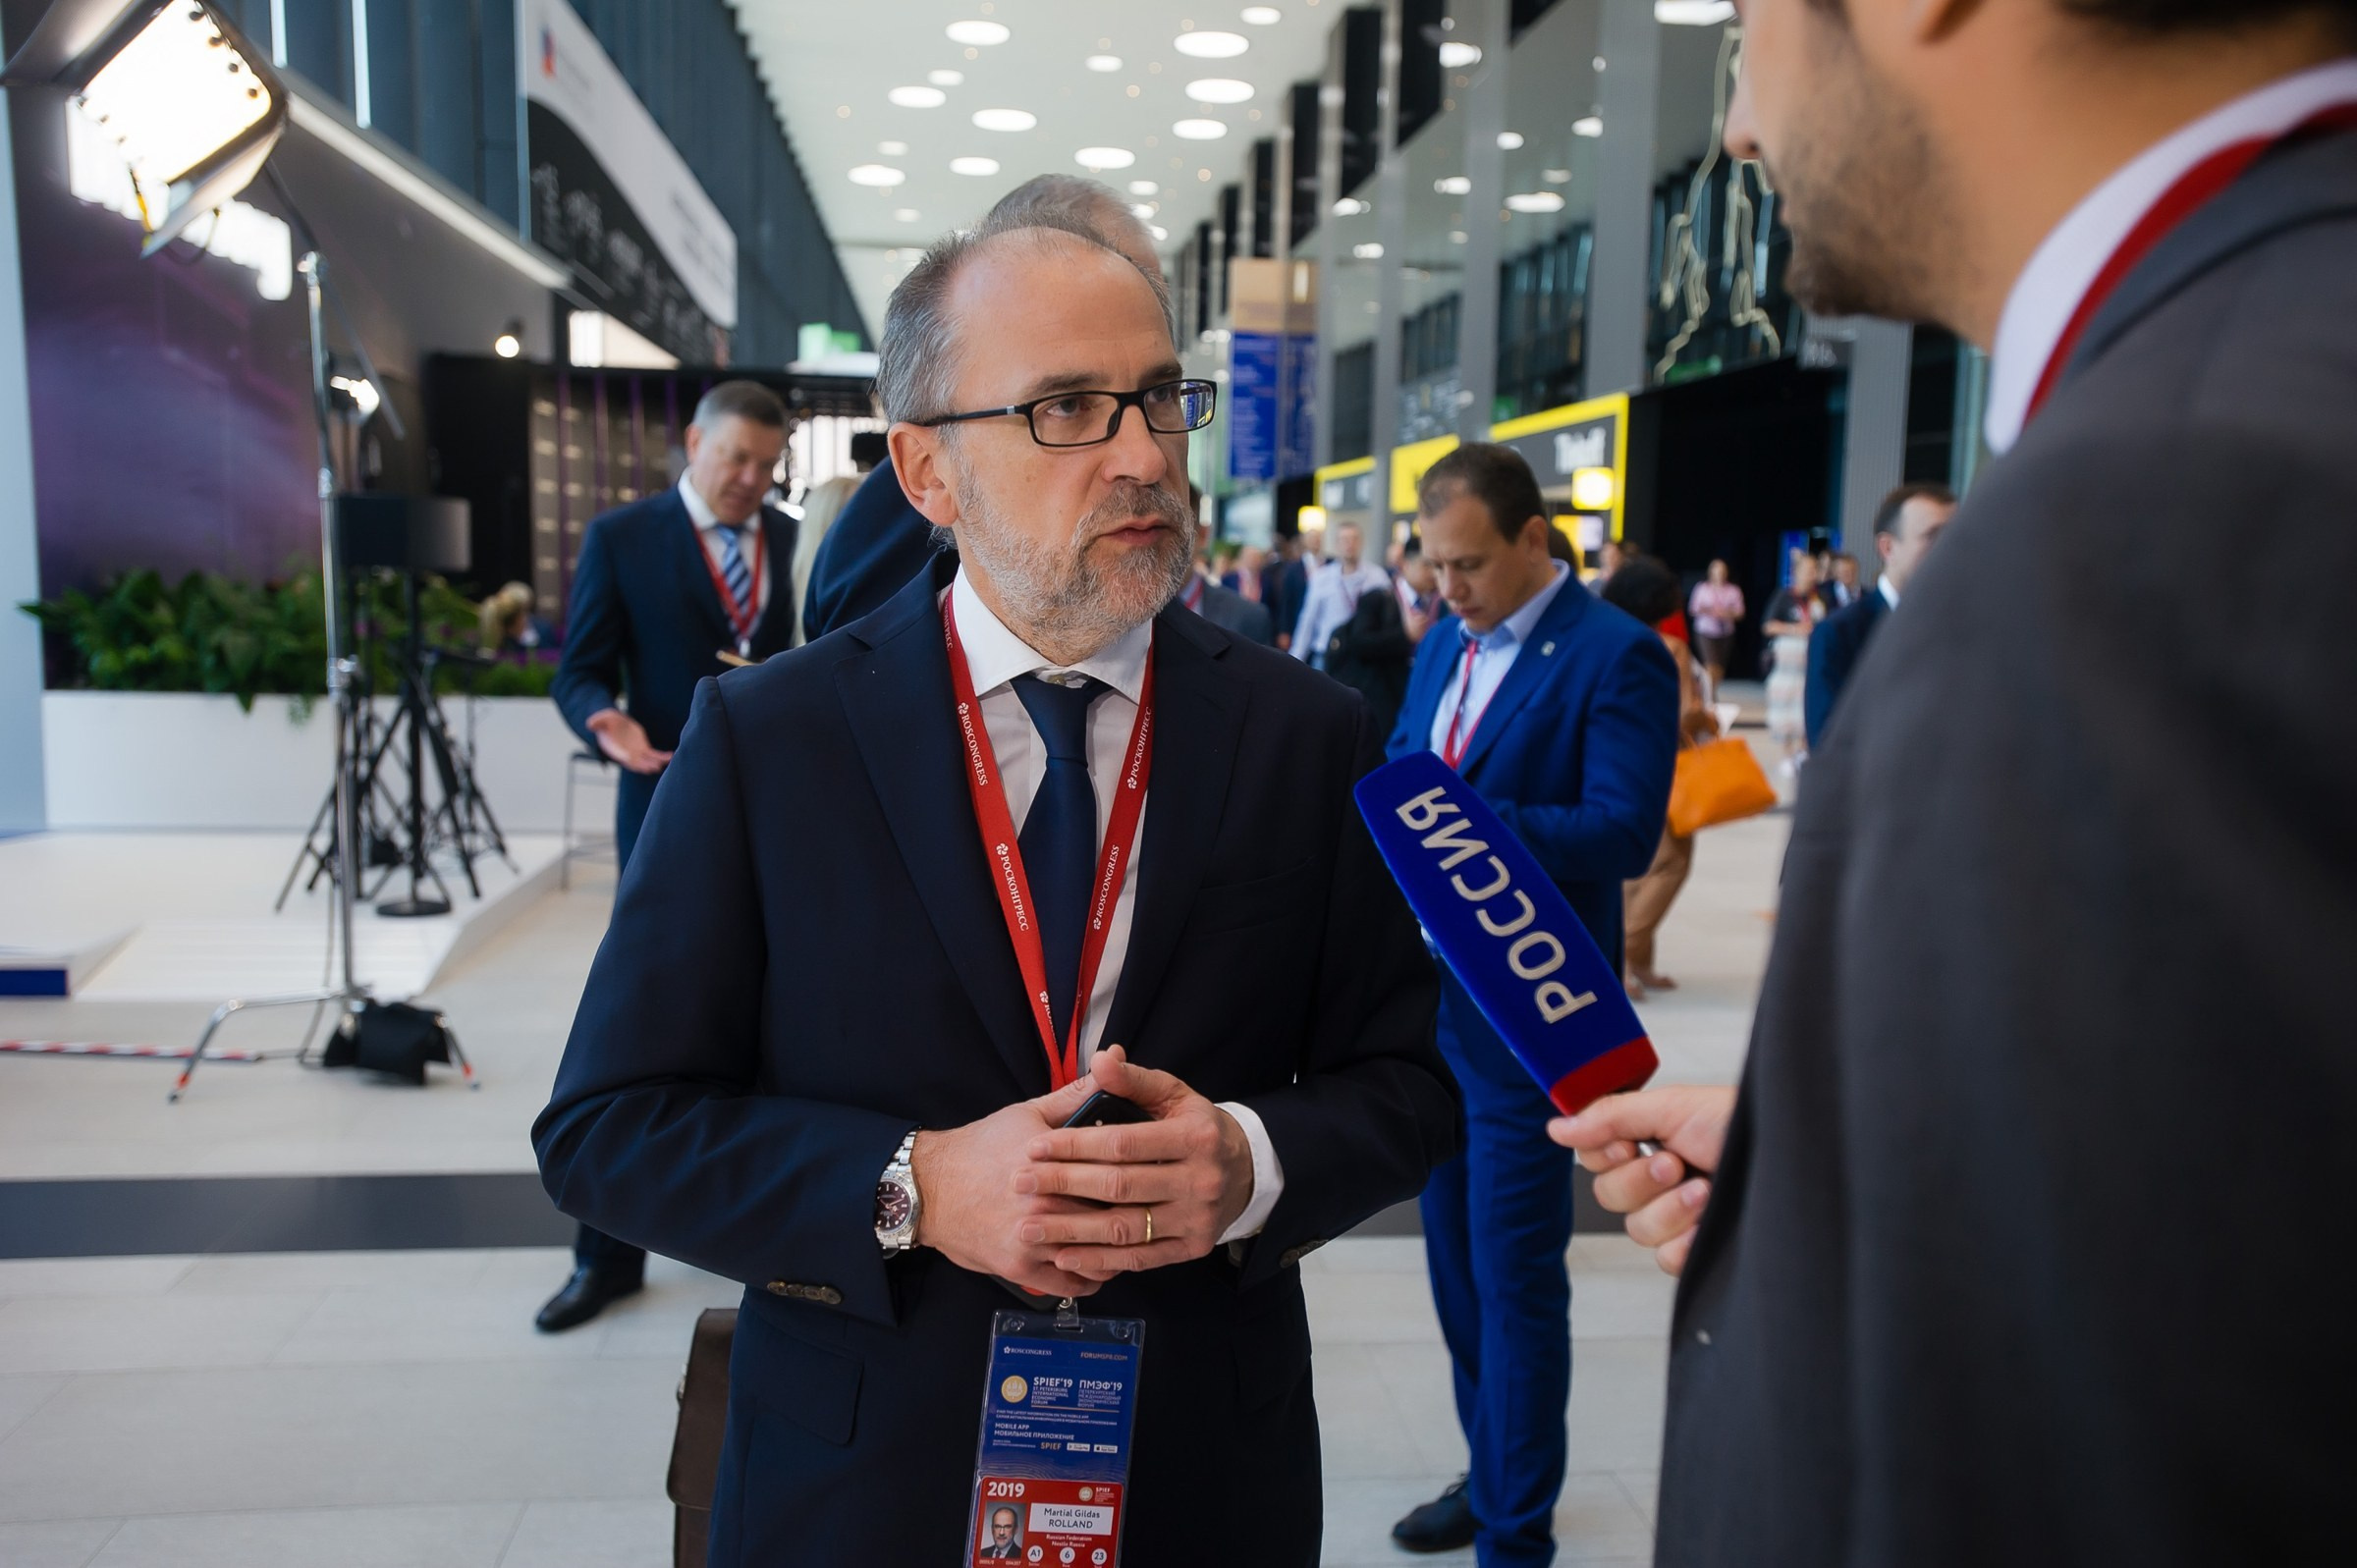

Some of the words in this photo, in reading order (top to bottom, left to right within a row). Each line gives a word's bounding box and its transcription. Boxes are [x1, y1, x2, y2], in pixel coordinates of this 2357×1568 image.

[1130, 706, 1153, 779] РОСКОНГРЕСС
[960, 713, 989, 786] ROSCONGRESS
[1097, 844, 1119, 918] ROSCONGRESS
[1001, 855, 1029, 932] РОСКОНГРЕСС
[1396, 785, 1598, 1024] РОССИЯ
[1011, 1347, 1053, 1356] ROSCONGRESS
[1079, 1379, 1123, 1391] ПМЭФ'19
[987, 1482, 1025, 1497] 2019
[1044, 1508, 1072, 1517] Martial
[1074, 1509, 1100, 1518] Gildas
[1048, 1519, 1093, 1529] ROLLAND
[1030, 1549, 1041, 1558] A1
[1064, 1551, 1070, 1559] 6
[1094, 1552, 1104, 1561] 23
